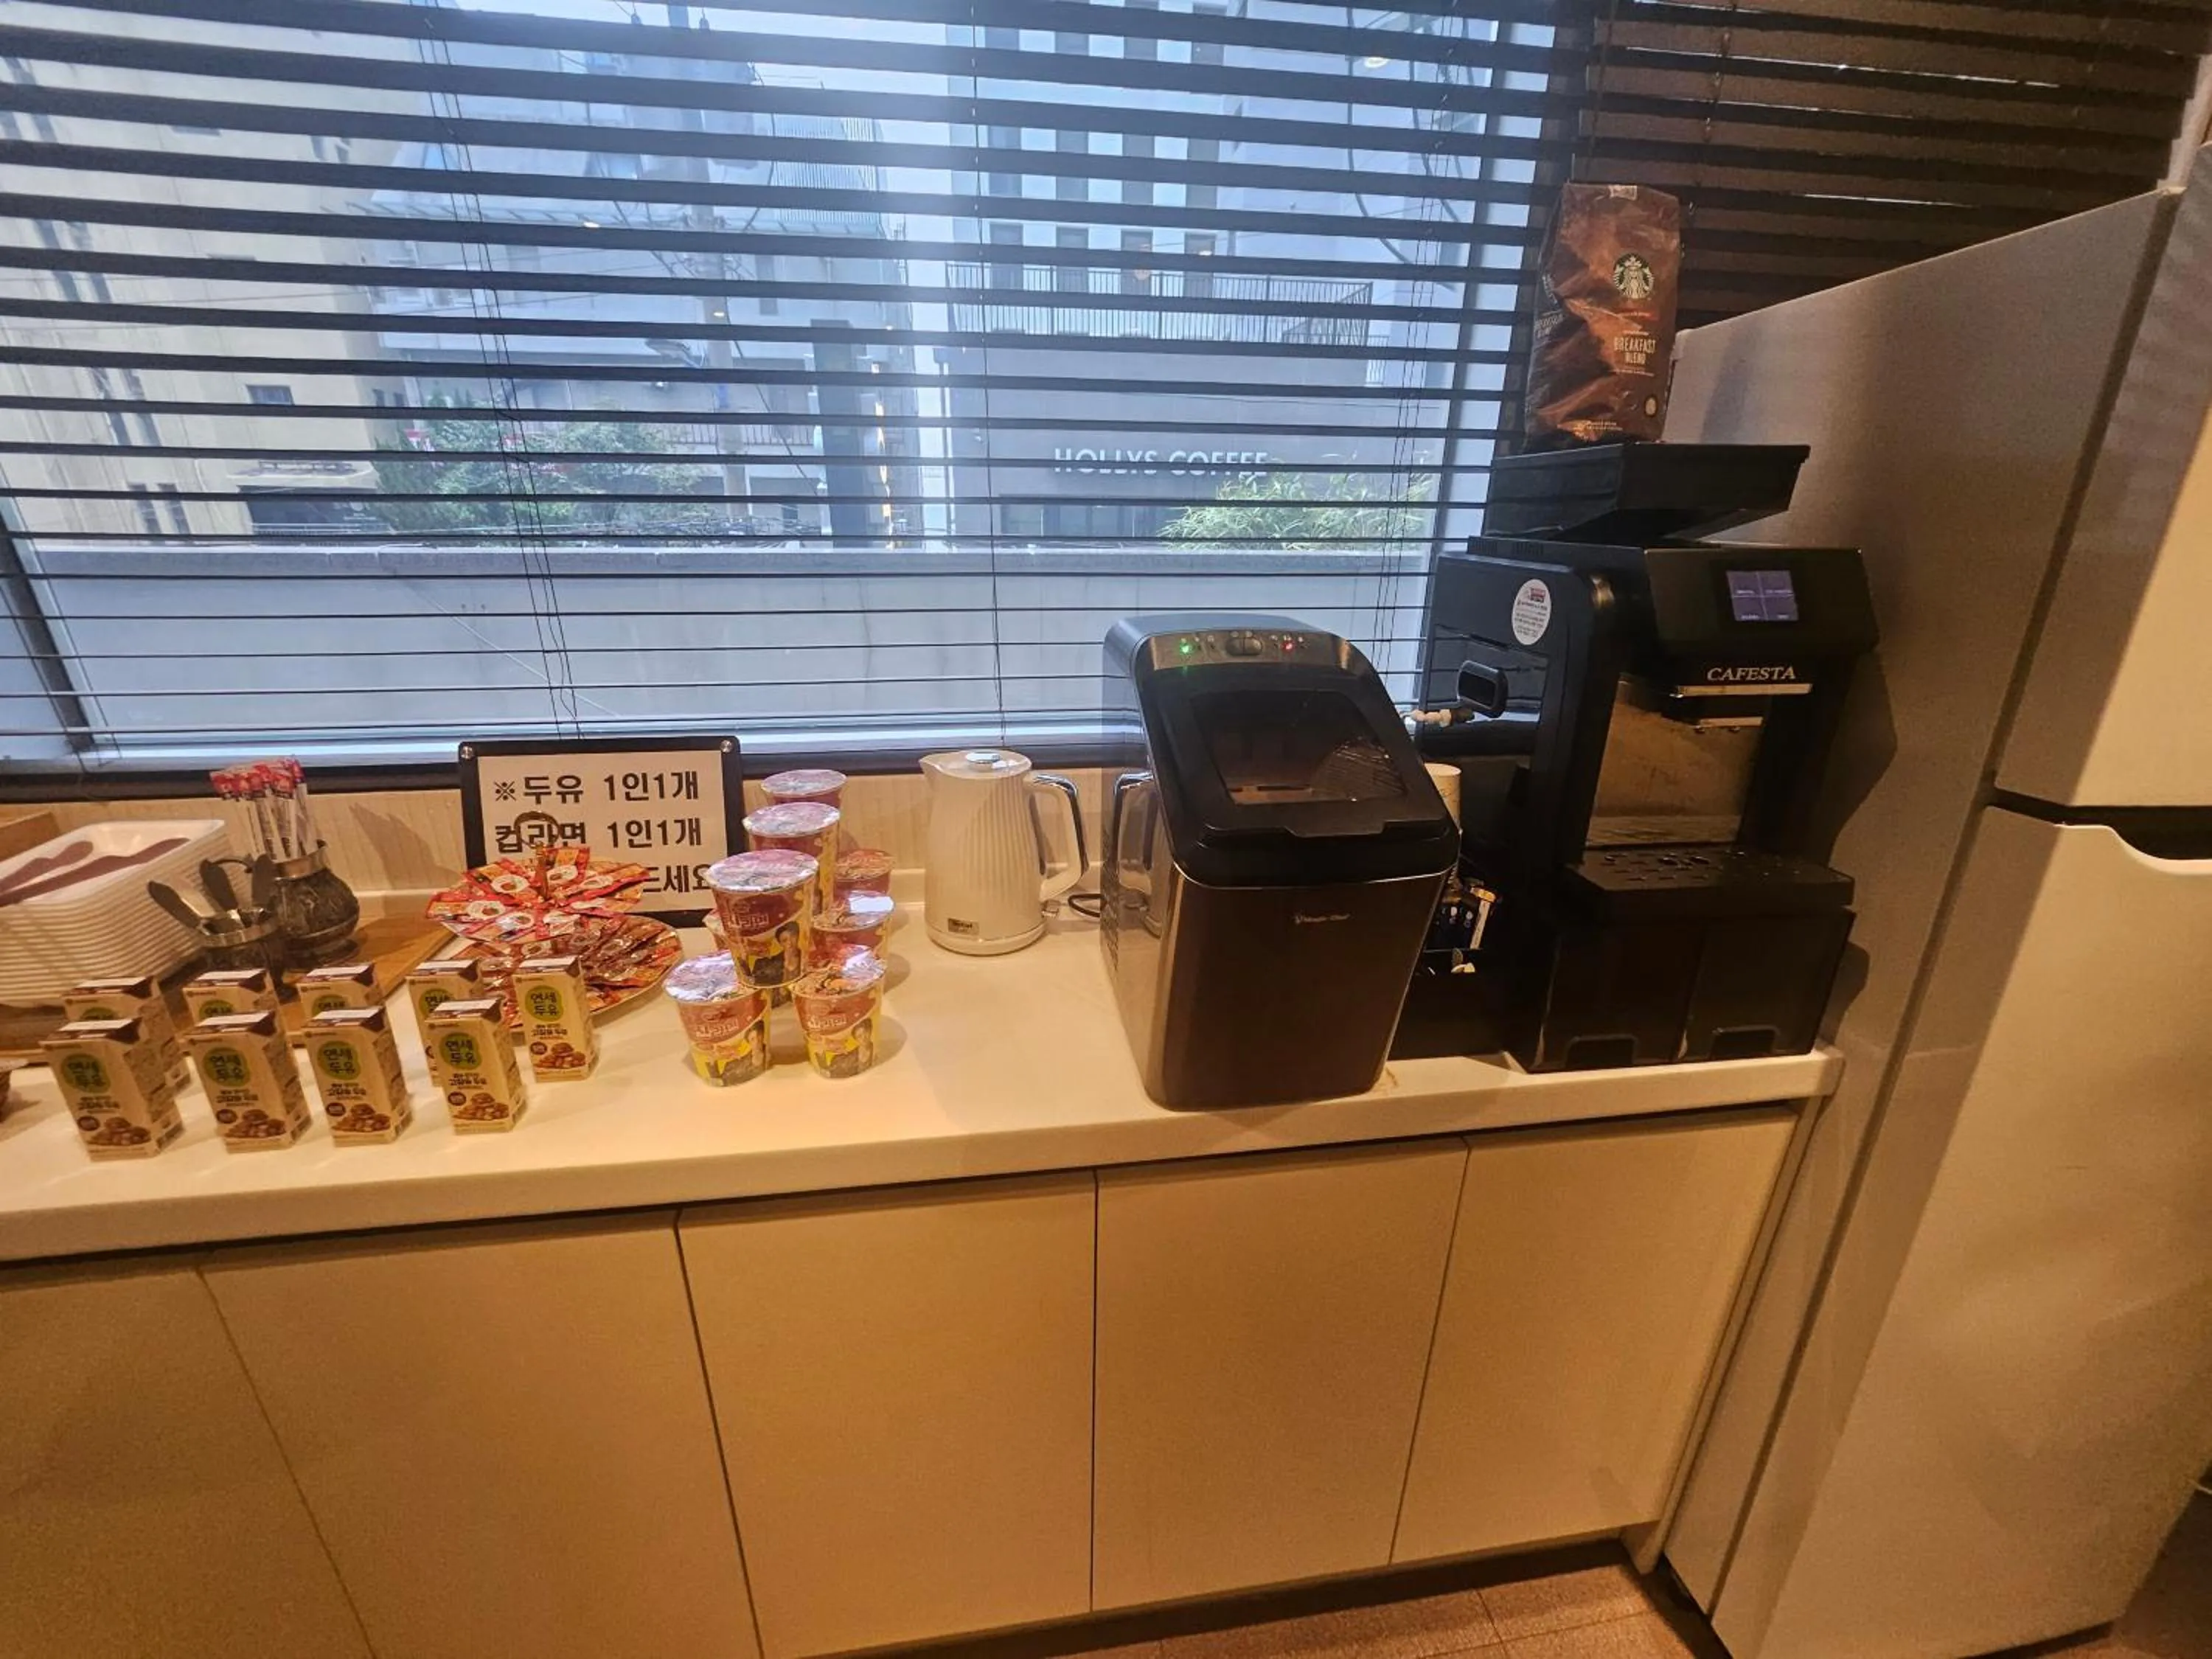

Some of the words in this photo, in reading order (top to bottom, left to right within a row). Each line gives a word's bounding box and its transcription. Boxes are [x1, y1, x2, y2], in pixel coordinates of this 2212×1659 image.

[1054, 448, 1158, 474] HOLLYS
[1169, 450, 1268, 476] COFFEE
[1706, 666, 1797, 681] CAFESTA
[604, 770, 700, 802] 1인1개
[495, 821, 586, 853] 컵라면
[607, 817, 702, 849] 1인1개
